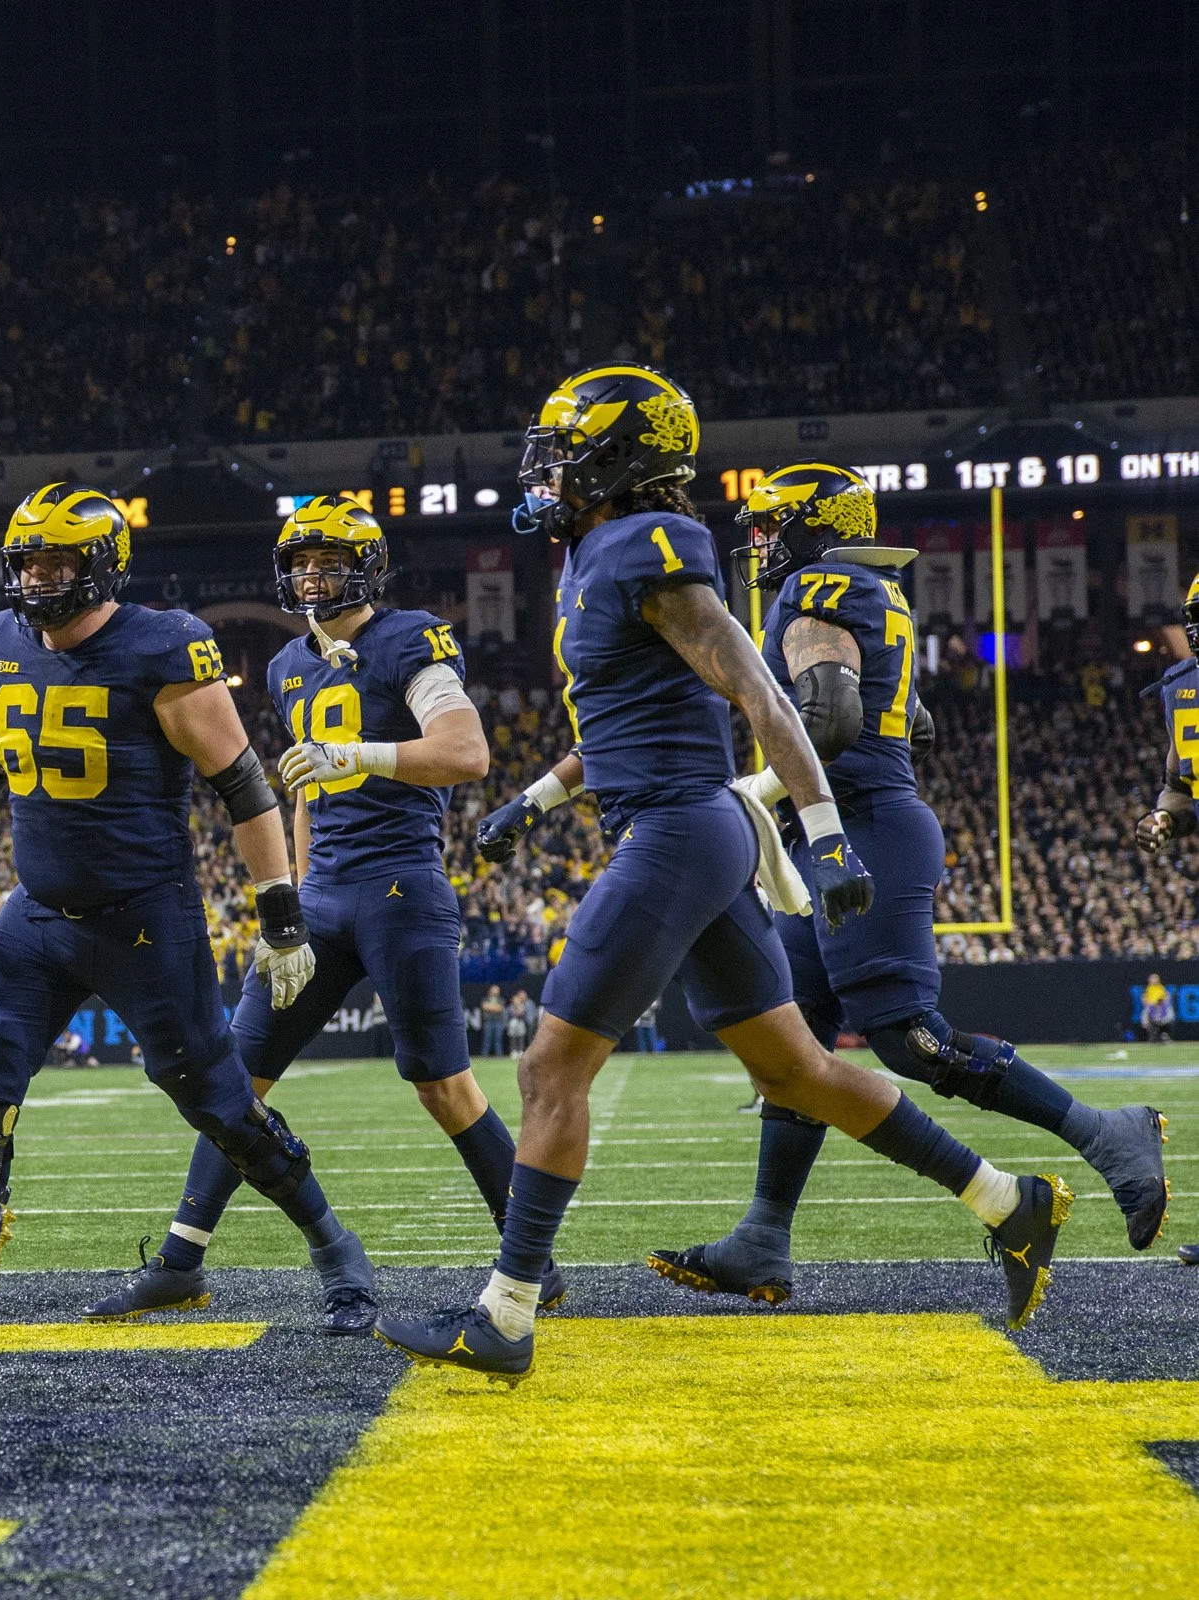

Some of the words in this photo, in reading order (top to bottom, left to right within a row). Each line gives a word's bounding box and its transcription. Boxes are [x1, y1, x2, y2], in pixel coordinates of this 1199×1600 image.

[420, 483, 457, 515] 21
[906, 463, 927, 490] 3
[955, 460, 1011, 489] 1ST
[1018, 456, 1046, 488] &
[1056, 454, 1100, 485] 10
[1120, 453, 1161, 479] ON
[651, 526, 684, 574] 1
[800, 573, 851, 610] 77
[187, 639, 223, 682] 65
